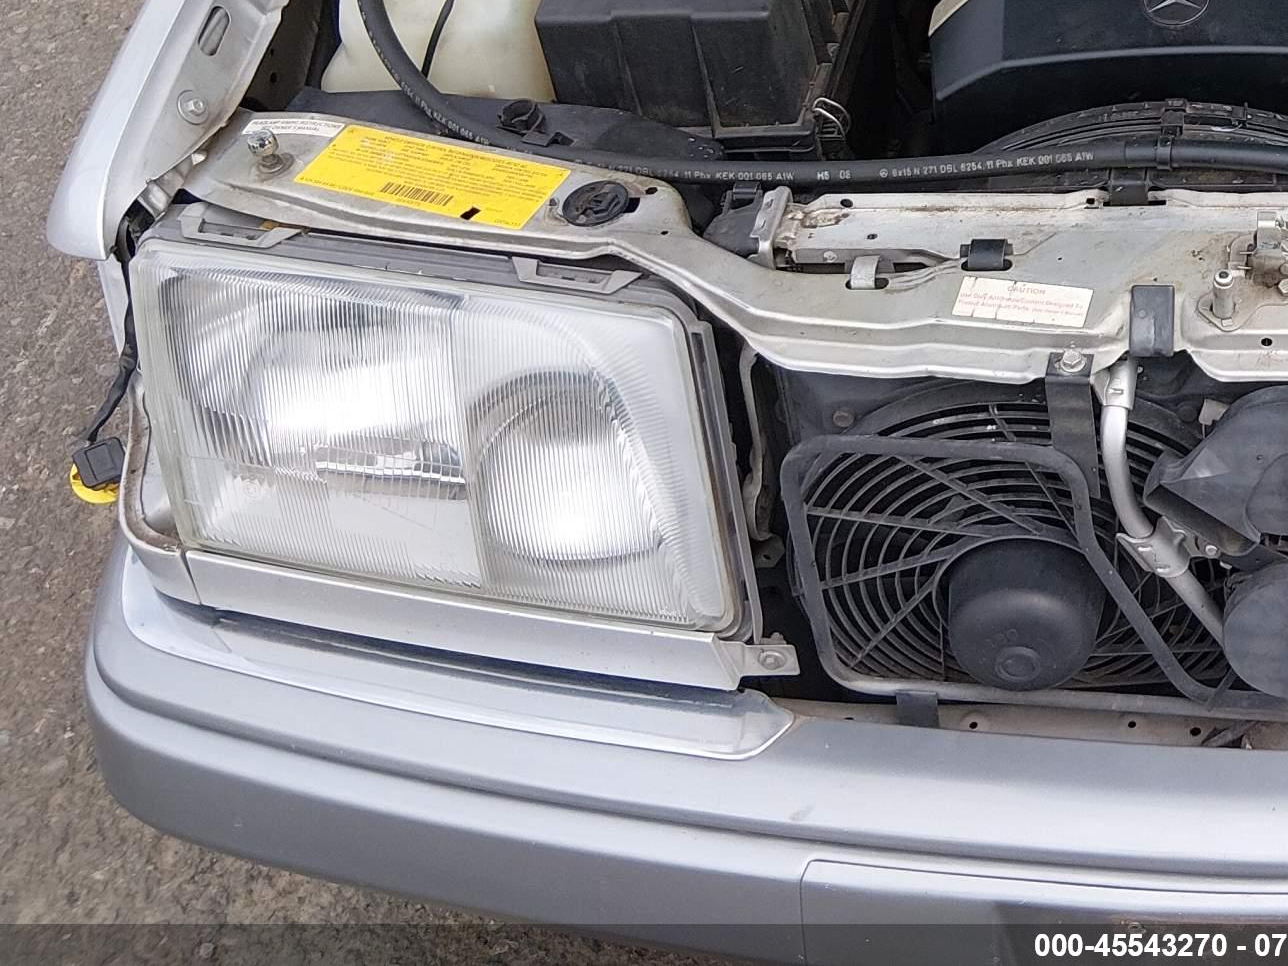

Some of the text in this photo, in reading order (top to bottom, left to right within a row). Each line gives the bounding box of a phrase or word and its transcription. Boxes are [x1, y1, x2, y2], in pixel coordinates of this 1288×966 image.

[1016, 155, 1036, 167] KEK
[716, 171, 736, 181] KEK
[1007, 285, 1046, 295] CAUTION
